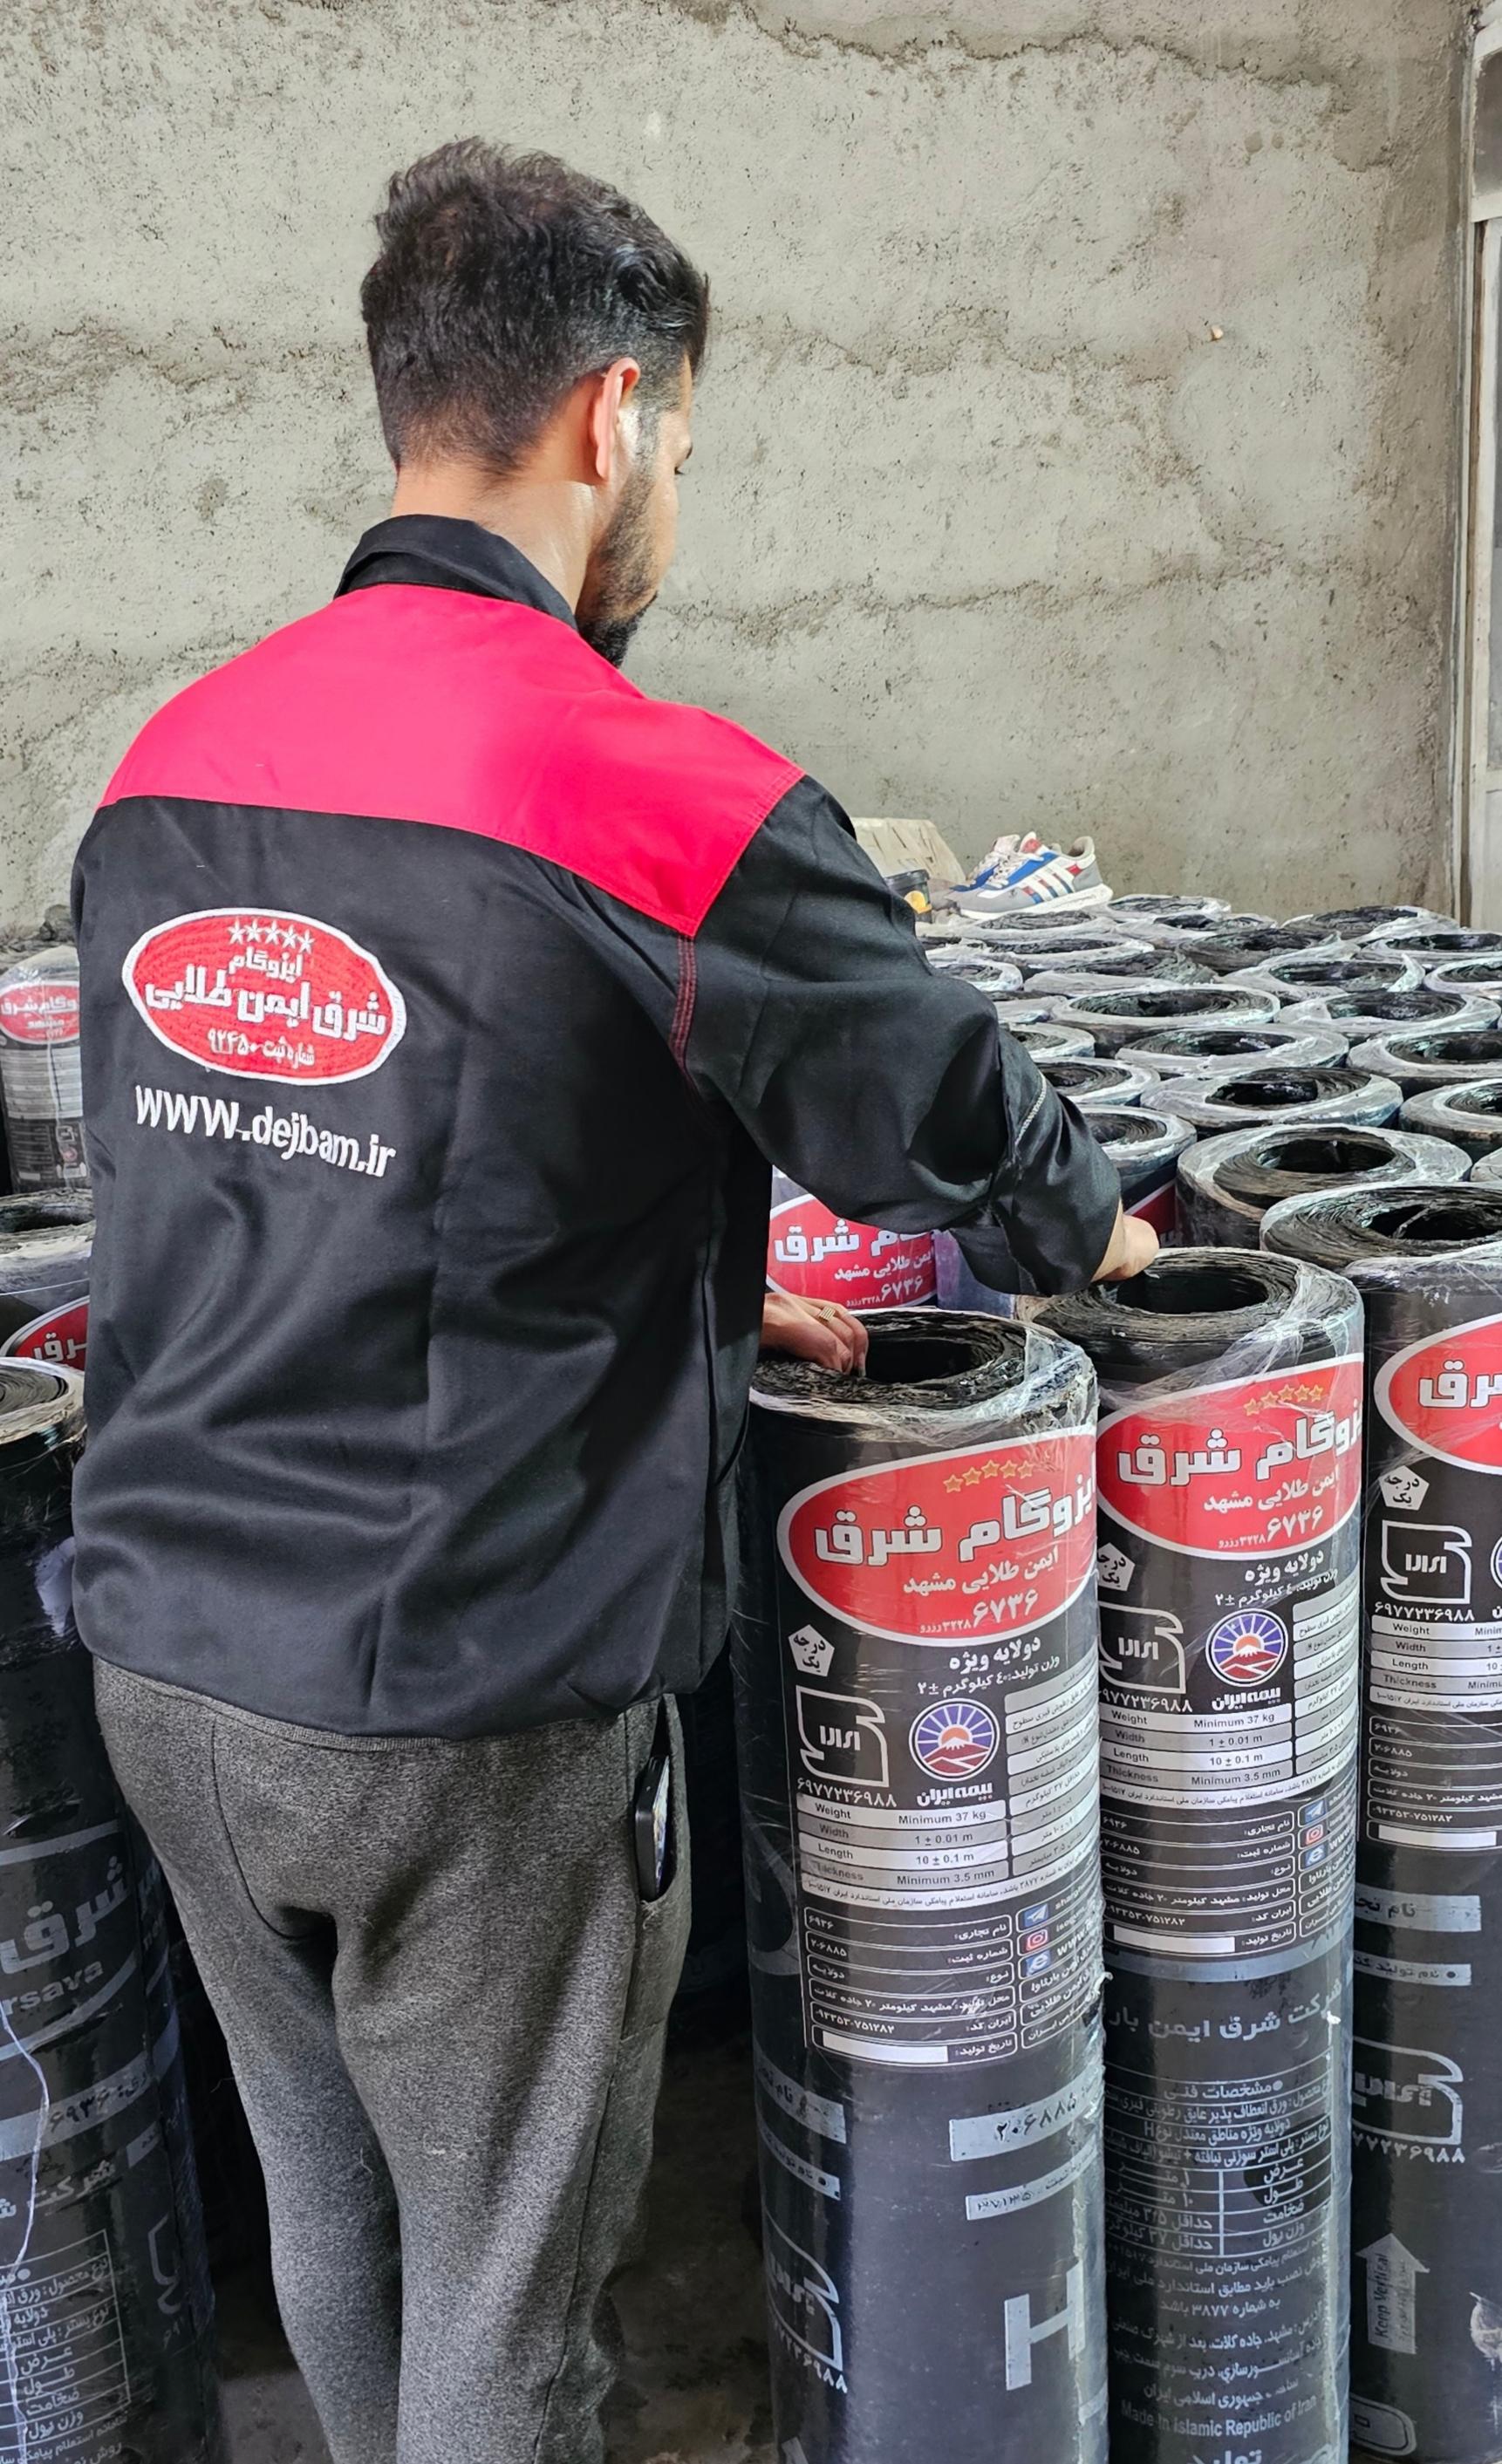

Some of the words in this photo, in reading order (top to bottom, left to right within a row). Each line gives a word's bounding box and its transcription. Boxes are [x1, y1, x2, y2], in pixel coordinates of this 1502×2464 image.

[228, 945, 304, 984] ایزوگام
[144, 963, 233, 1011] طلایی
[236, 980, 312, 1028] ایمن
[312, 990, 386, 1041] شرق
[773, 1218, 860, 1263] شرق
[833, 1263, 870, 1281] مشهد
[873, 1254, 910, 1279] طلایی
[1116, 1427, 1243, 1487] شرق
[1203, 1490, 1253, 1514] مشهد
[1257, 1478, 1308, 1512] طلایی
[1392, 1492, 1413, 1508] یک
[1266, 1505, 1324, 1543] ۶۷۳۶
[813, 1505, 943, 1567] شرق
[1023, 1544, 1059, 1580] ایمن
[1284, 1549, 1325, 1577] دولایه
[903, 1572, 957, 1596] مشهد
[961, 1560, 1020, 1594] طلایی
[1102, 1571, 1121, 1585] یک
[1245, 1563, 1281, 1587] ویژه
[973, 1588, 1039, 1628] ۶۷۳۶
[1392, 1622, 1430, 1635] Weight
[793, 1632, 827, 1655] درجه
[993, 1636, 1041, 1665] دولایه
[1395, 1640, 1427, 1654] Width
[801, 1654, 821, 1674] یک
[949, 1650, 990, 1675] ویژه
[1391, 1657, 1429, 1671] Length
[942, 1674, 994, 1698] کیلوگرم
[1383, 1673, 1437, 1689] Thickness
[1211, 1692, 1246, 1712] ایران
[1111, 1709, 1148, 1726] Weight
[1193, 1717, 1245, 1729] Minimum
[1246, 1715, 1260, 1725] 37
[1262, 1712, 1275, 1724] kg
[1115, 1729, 1145, 1744] Width
[1227, 1735, 1250, 1746] 0.01
[1113, 1747, 1150, 1764] Length
[1209, 1756, 1222, 1766] 10
[1235, 1753, 1251, 1764] 0.1
[1106, 1764, 1159, 1784] Thickness
[1191, 1774, 1241, 1786] Minimum
[1243, 1771, 1260, 1782] 3.5
[1262, 1767, 1281, 1778] mm
[916, 1786, 954, 1807] ایران
[815, 1801, 851, 1820] Weight
[898, 1812, 952, 1826] Minimum
[955, 1811, 970, 1823] 37
[973, 1809, 987, 1823] kg
[818, 1823, 850, 1839] Width
[935, 1833, 959, 1845] 0.01
[1274, 1819, 1291, 1833] نام
[818, 1843, 854, 1860] Length
[916, 1854, 930, 1865] 10
[943, 1852, 960, 1864] 0.1
[1262, 1841, 1292, 1855] شماره
[897, 1874, 950, 1886] Minimum
[953, 1872, 972, 1883] 3.5
[973, 1869, 995, 1879] mm
[898, 1898, 923, 1908] سازمان
[1210, 1894, 1240, 1906] مشهد
[0, 1854, 130, 1976] شرق
[1269, 1905, 1293, 1920] ایران
[992, 1922, 1007, 1937] نام
[976, 1947, 1008, 1962] شماره
[0, 1961, 105, 2017] rsava
[987, 2015, 1013, 2031] ایران
[1148, 2019, 1211, 2044] ایمن
[1219, 2010, 1281, 2041] شرق
[1164, 2084, 1198, 2101] فنی
[1202, 2079, 1273, 2100] مشخصات
[1208, 2131, 1239, 2147] مناطق
[1263, 2158, 1305, 2185] عرض
[1264, 2177, 1304, 2205] طول
[1262, 2198, 1305, 2225] ضخامت
[1171, 2214, 1213, 2233] حداقل
[1286, 2222, 1306, 2240] وزن
[1171, 2234, 1213, 2252] حداقل
[1214, 2260, 1250, 2276] سازمان
[1157, 2278, 1215, 2296] استاندارد
[1217, 2281, 1252, 2298] مطابق
[14, 2306, 49, 2328] دولایه
[1232, 2298, 1266, 2318] شماره
[1239, 2332, 1263, 2351] جاده
[20, 2345, 73, 2376] عرض
[24, 2365, 76, 2396] طول
[26, 2386, 80, 2416] ضخامت
[58, 2410, 85, 2431] وزن
[1121, 2399, 1155, 2426] Made
[1225, 2408, 1282, 2439] Republic
[1283, 2403, 1297, 2425] of
[1296, 2393, 1318, 2417] Iran
